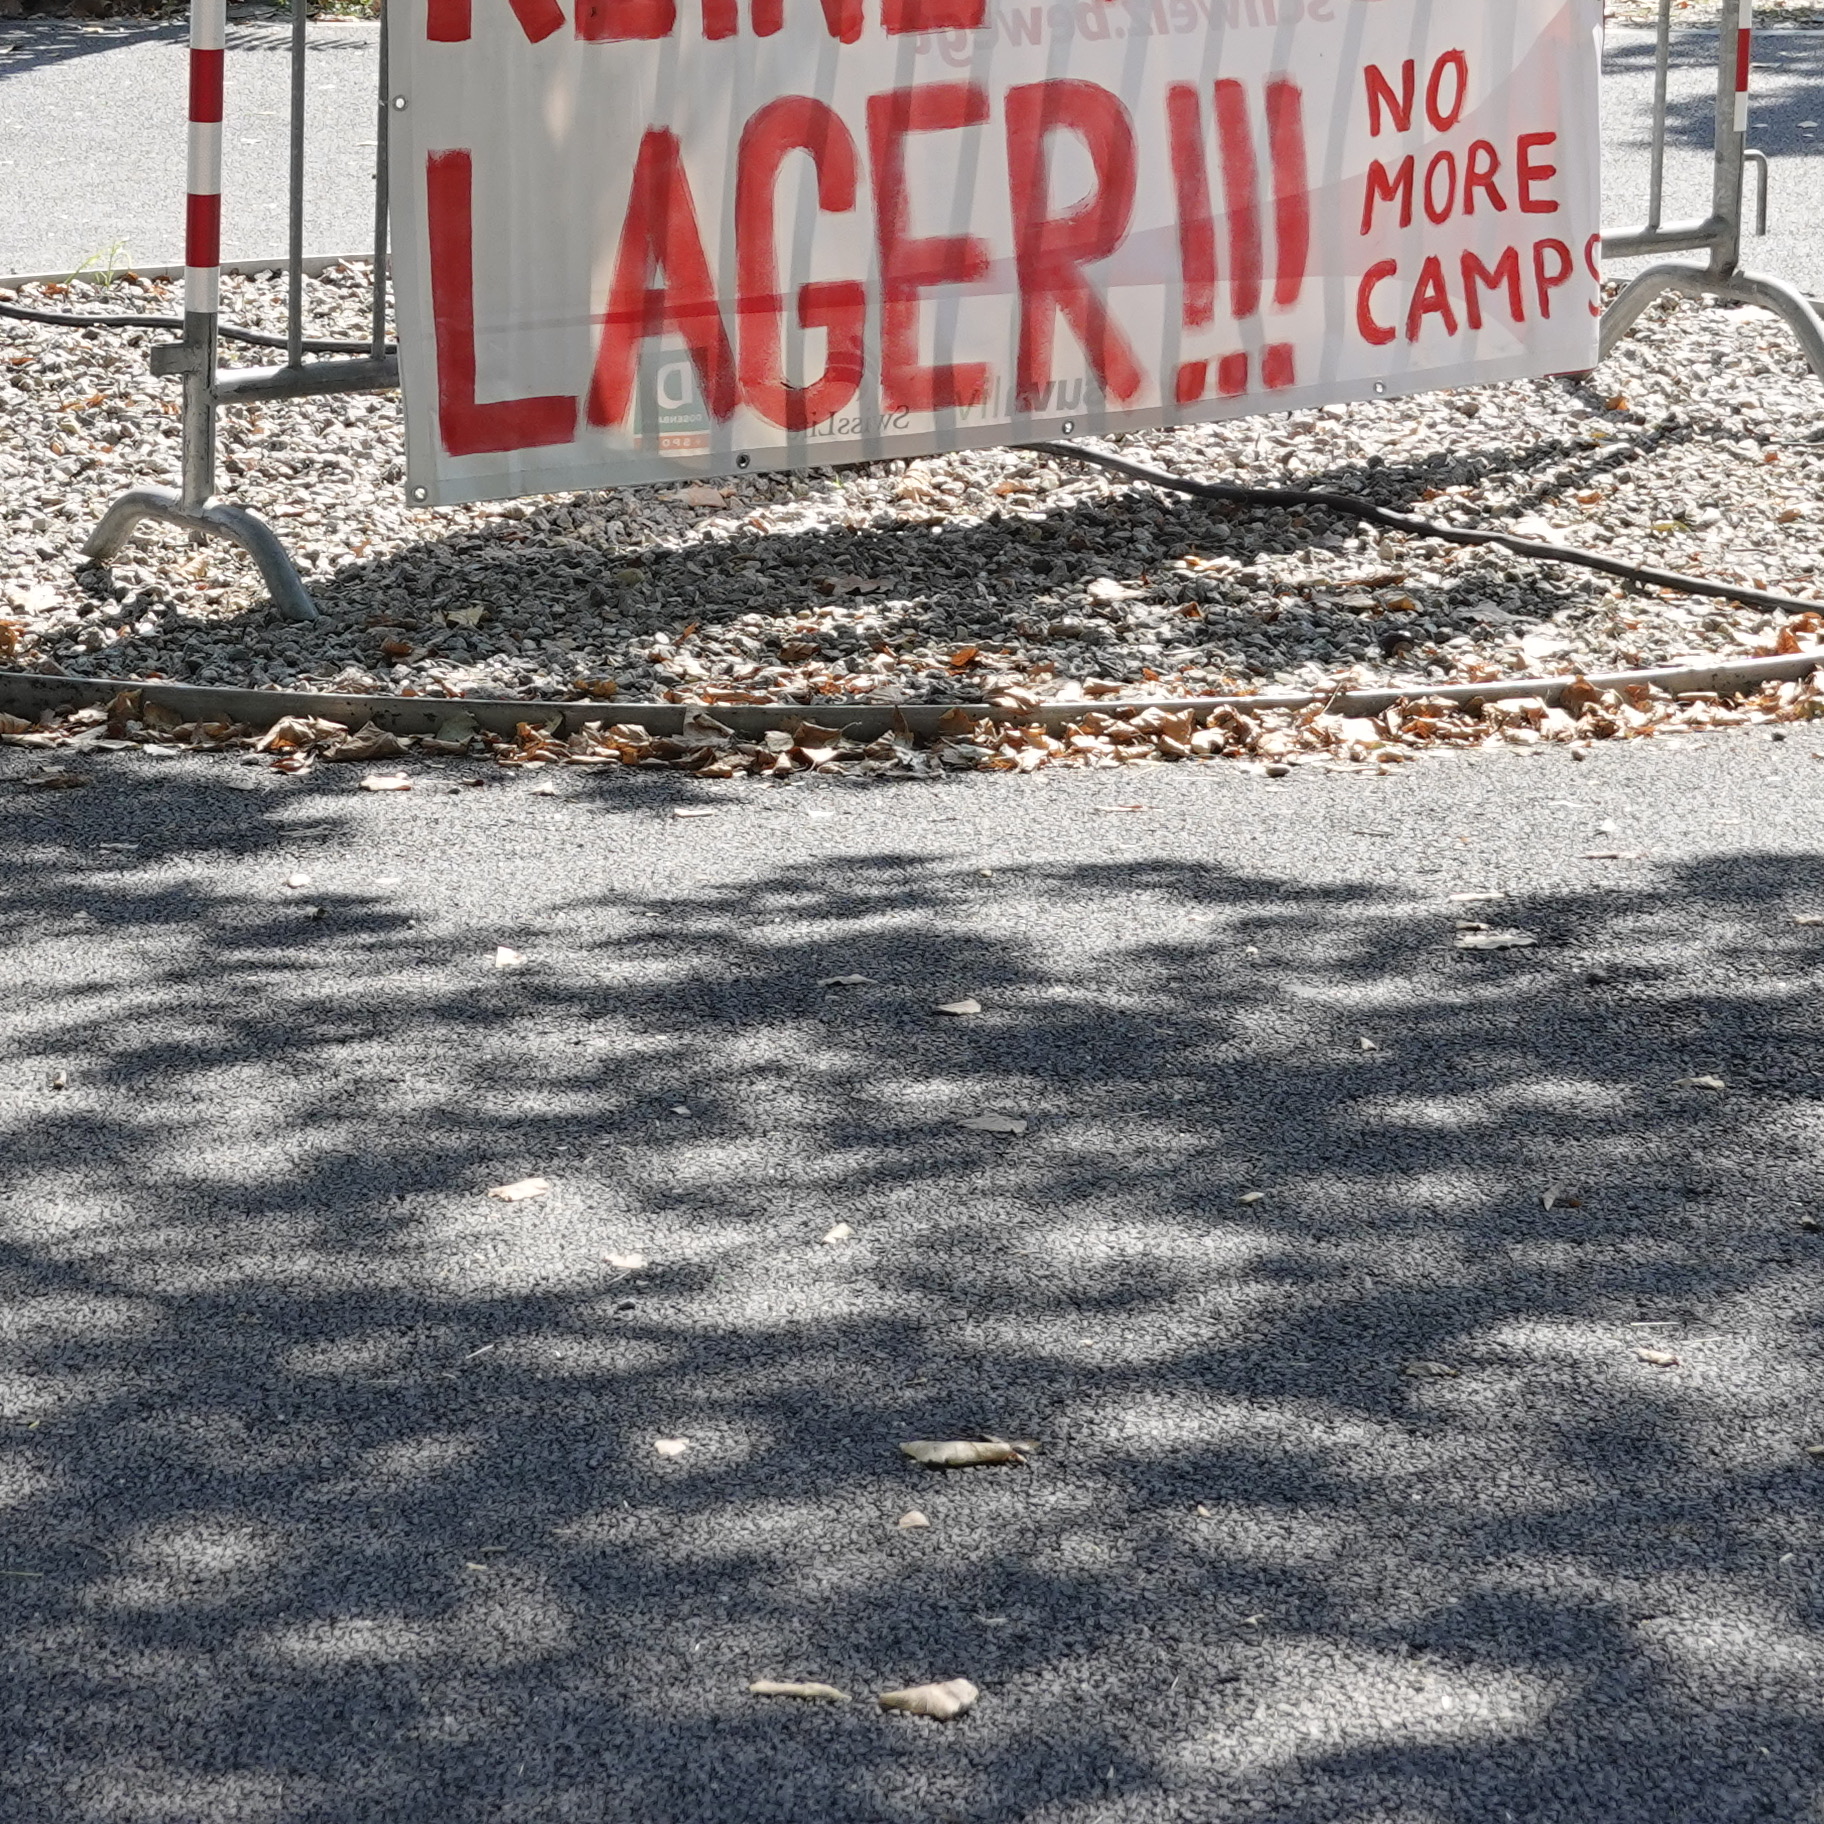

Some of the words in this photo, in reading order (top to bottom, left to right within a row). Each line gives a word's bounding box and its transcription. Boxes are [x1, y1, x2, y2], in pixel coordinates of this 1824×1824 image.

[1364, 48, 1468, 137] NO
[1360, 131, 1559, 236] MORE
[426, 78, 1308, 456] LAGER!!!
